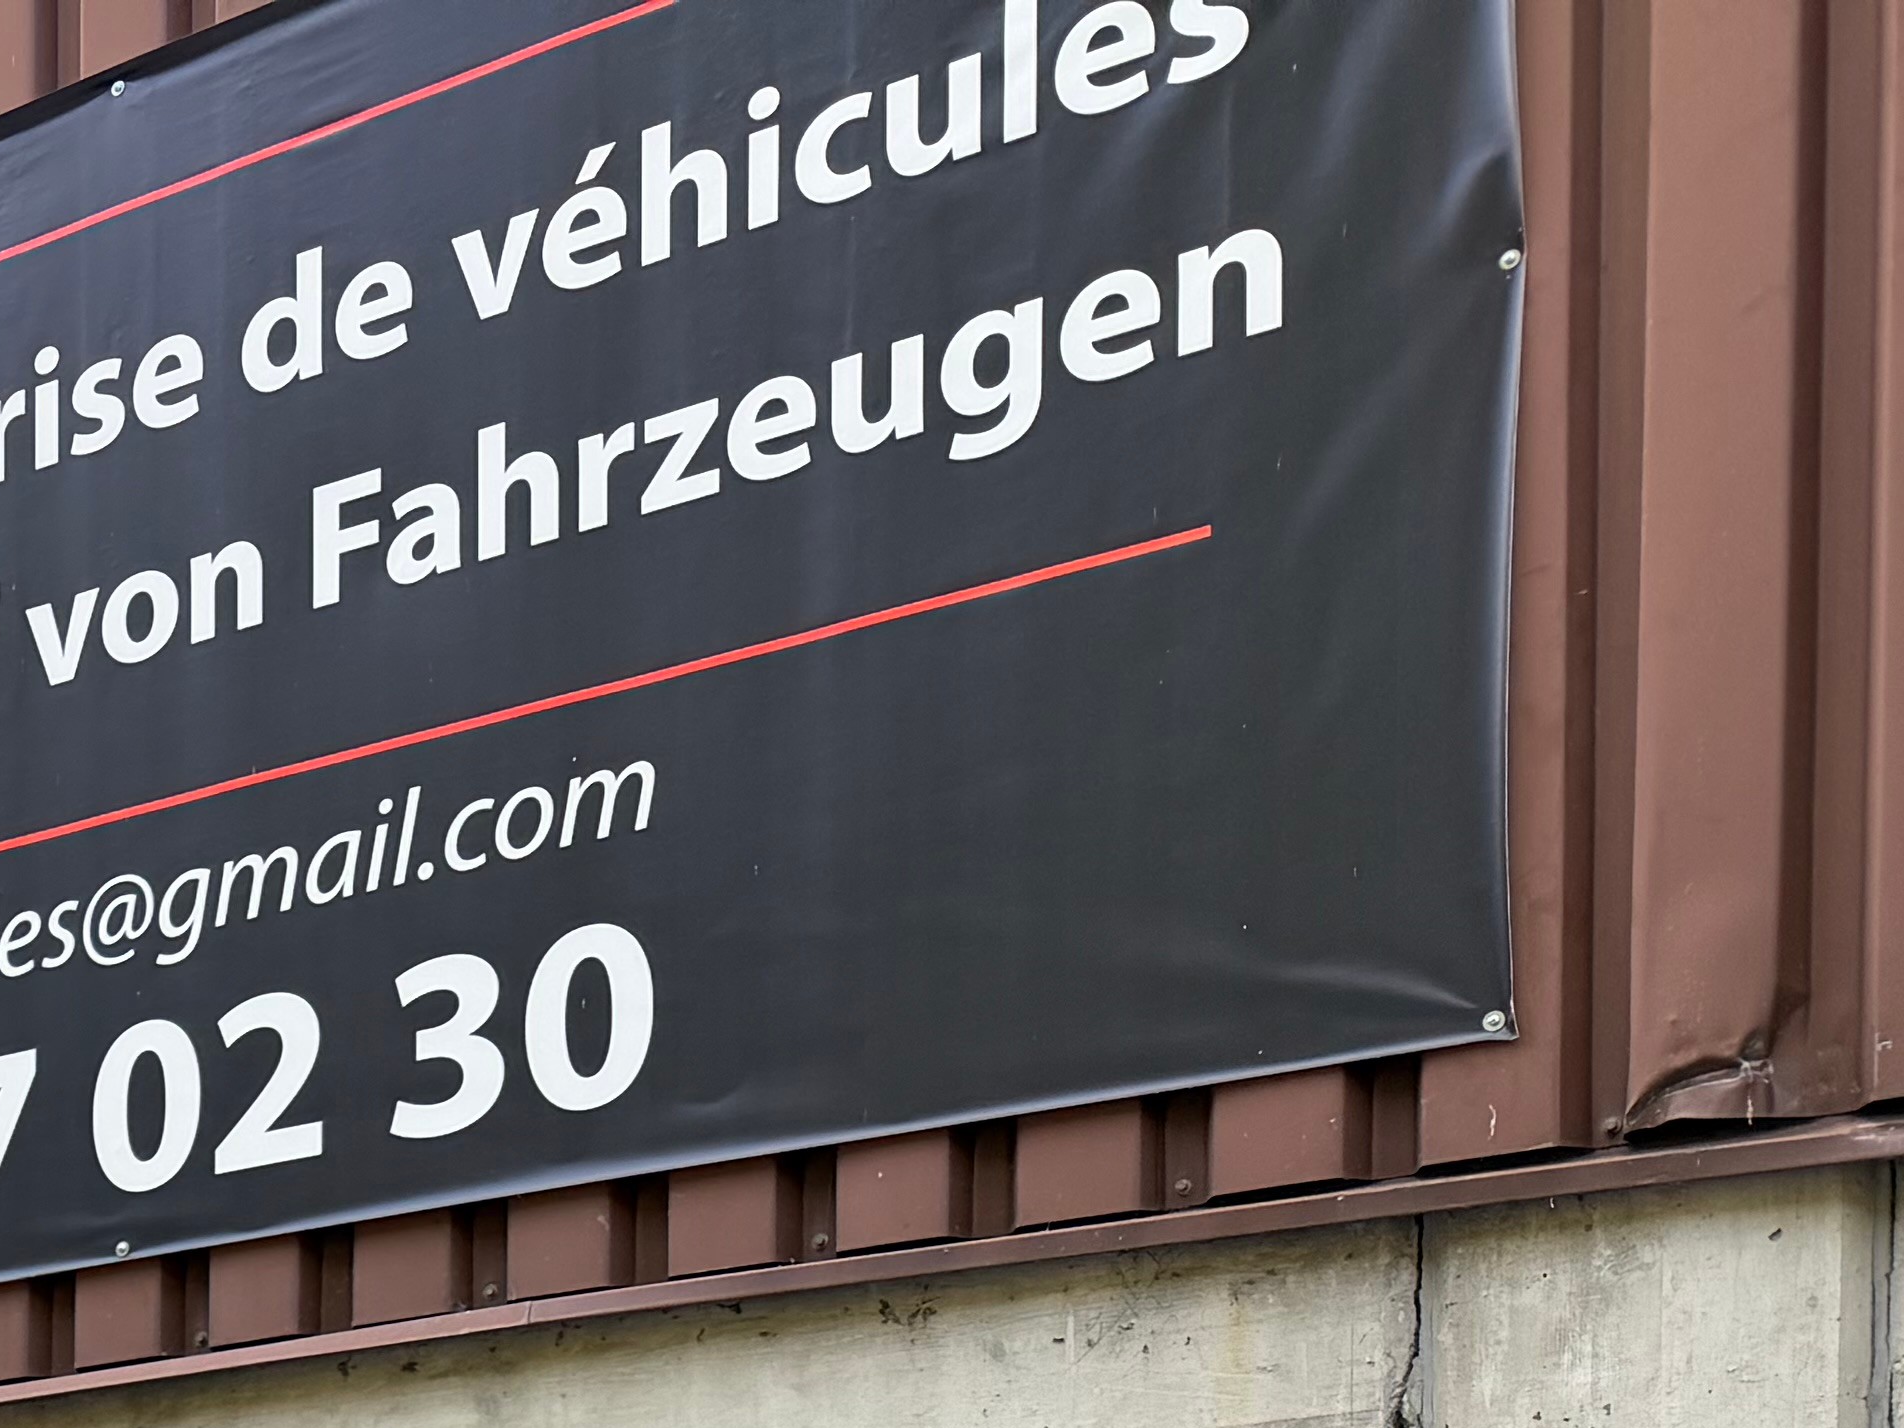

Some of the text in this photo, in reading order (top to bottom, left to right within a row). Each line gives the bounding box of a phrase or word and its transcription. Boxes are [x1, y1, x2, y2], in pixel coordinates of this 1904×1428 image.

[241, 246, 414, 393] de
[450, 0, 1251, 321] véhicules
[25, 540, 264, 687] von
[312, 226, 1283, 610] Fahrzeugen
[92, 991, 325, 1193] 02
[389, 922, 655, 1139] 30
